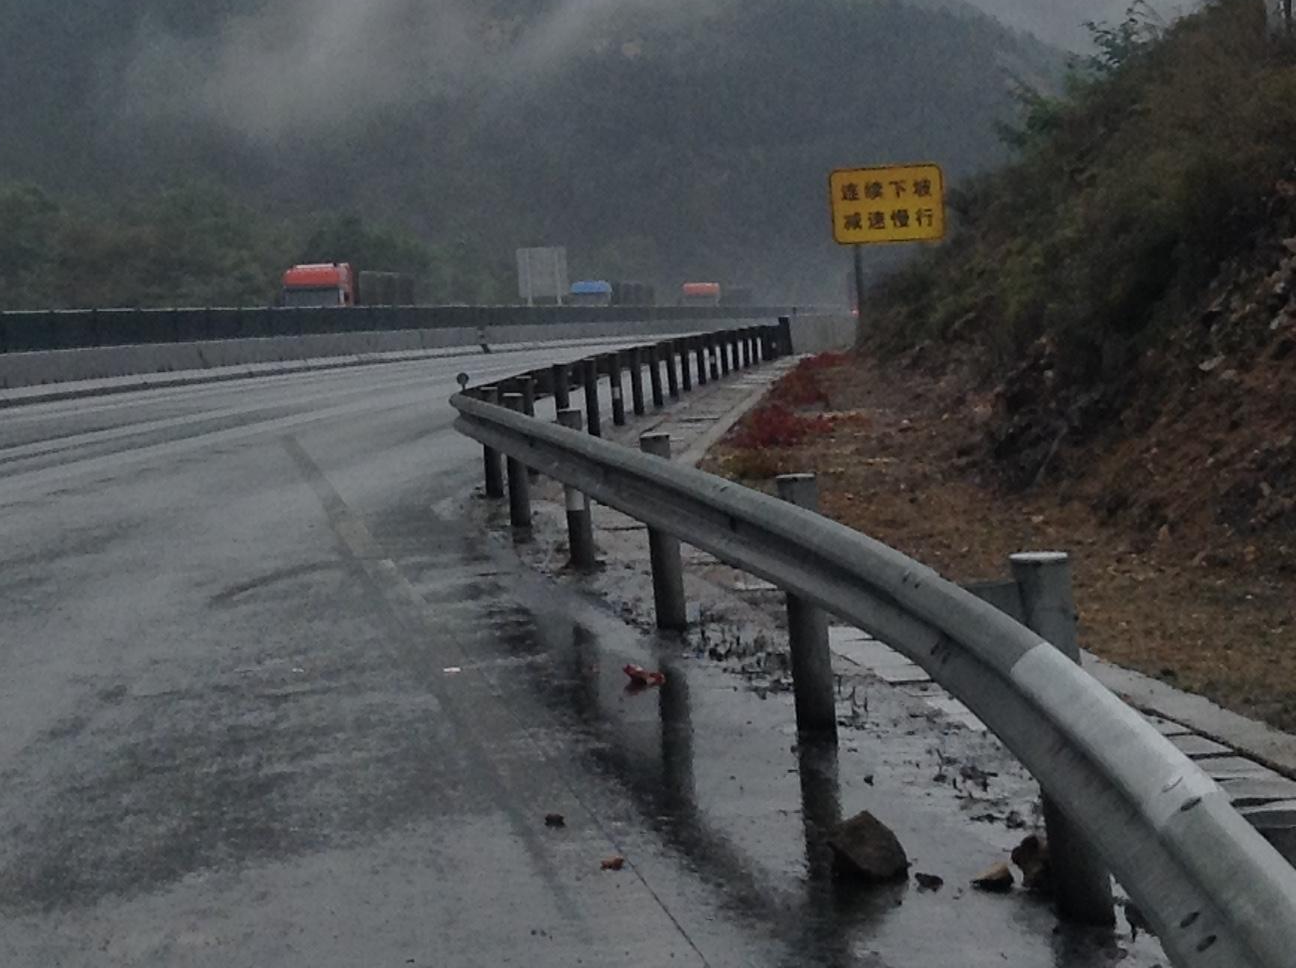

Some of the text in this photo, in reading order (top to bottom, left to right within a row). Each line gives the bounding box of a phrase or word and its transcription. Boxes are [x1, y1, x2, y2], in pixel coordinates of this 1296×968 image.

[841, 178, 932, 201] 连续下坡
[844, 208, 933, 230] 减速慢行
